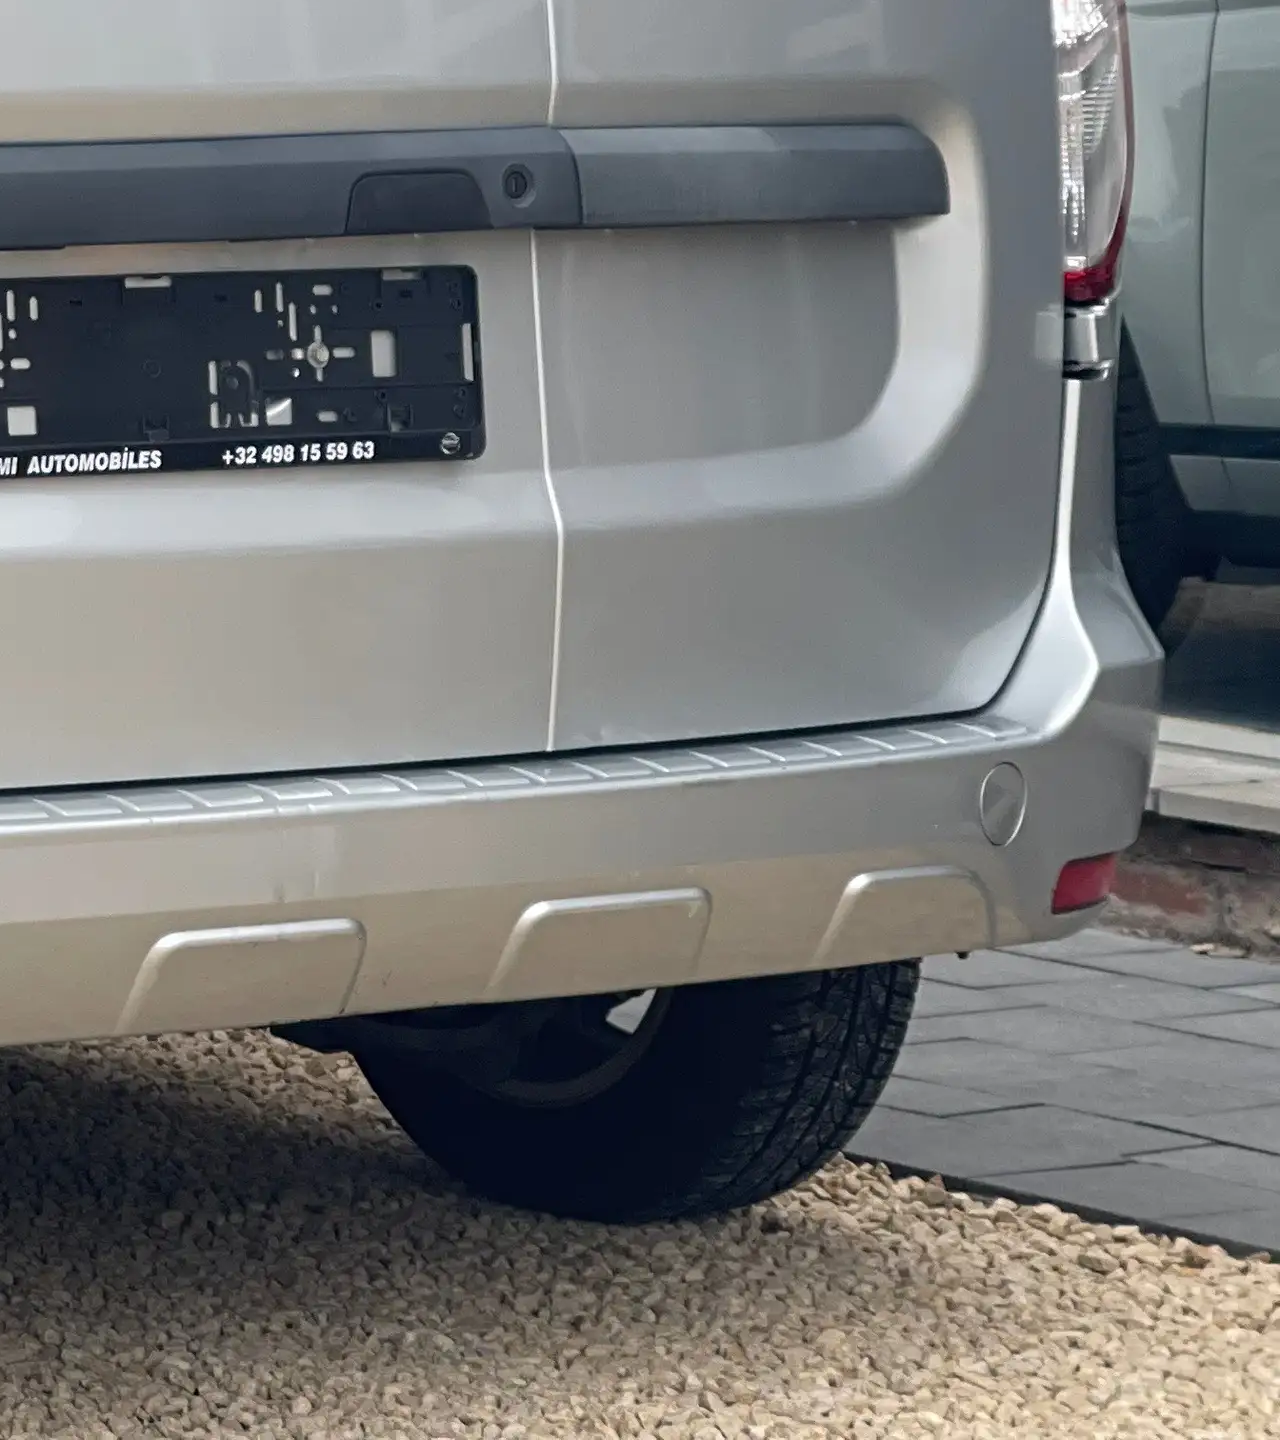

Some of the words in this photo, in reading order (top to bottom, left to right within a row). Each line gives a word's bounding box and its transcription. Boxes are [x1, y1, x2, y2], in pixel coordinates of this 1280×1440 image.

[222, 445, 257, 465] +32
[261, 444, 295, 463] 498
[300, 442, 321, 461] 15
[326, 441, 348, 460] 59
[352, 440, 375, 459] 63
